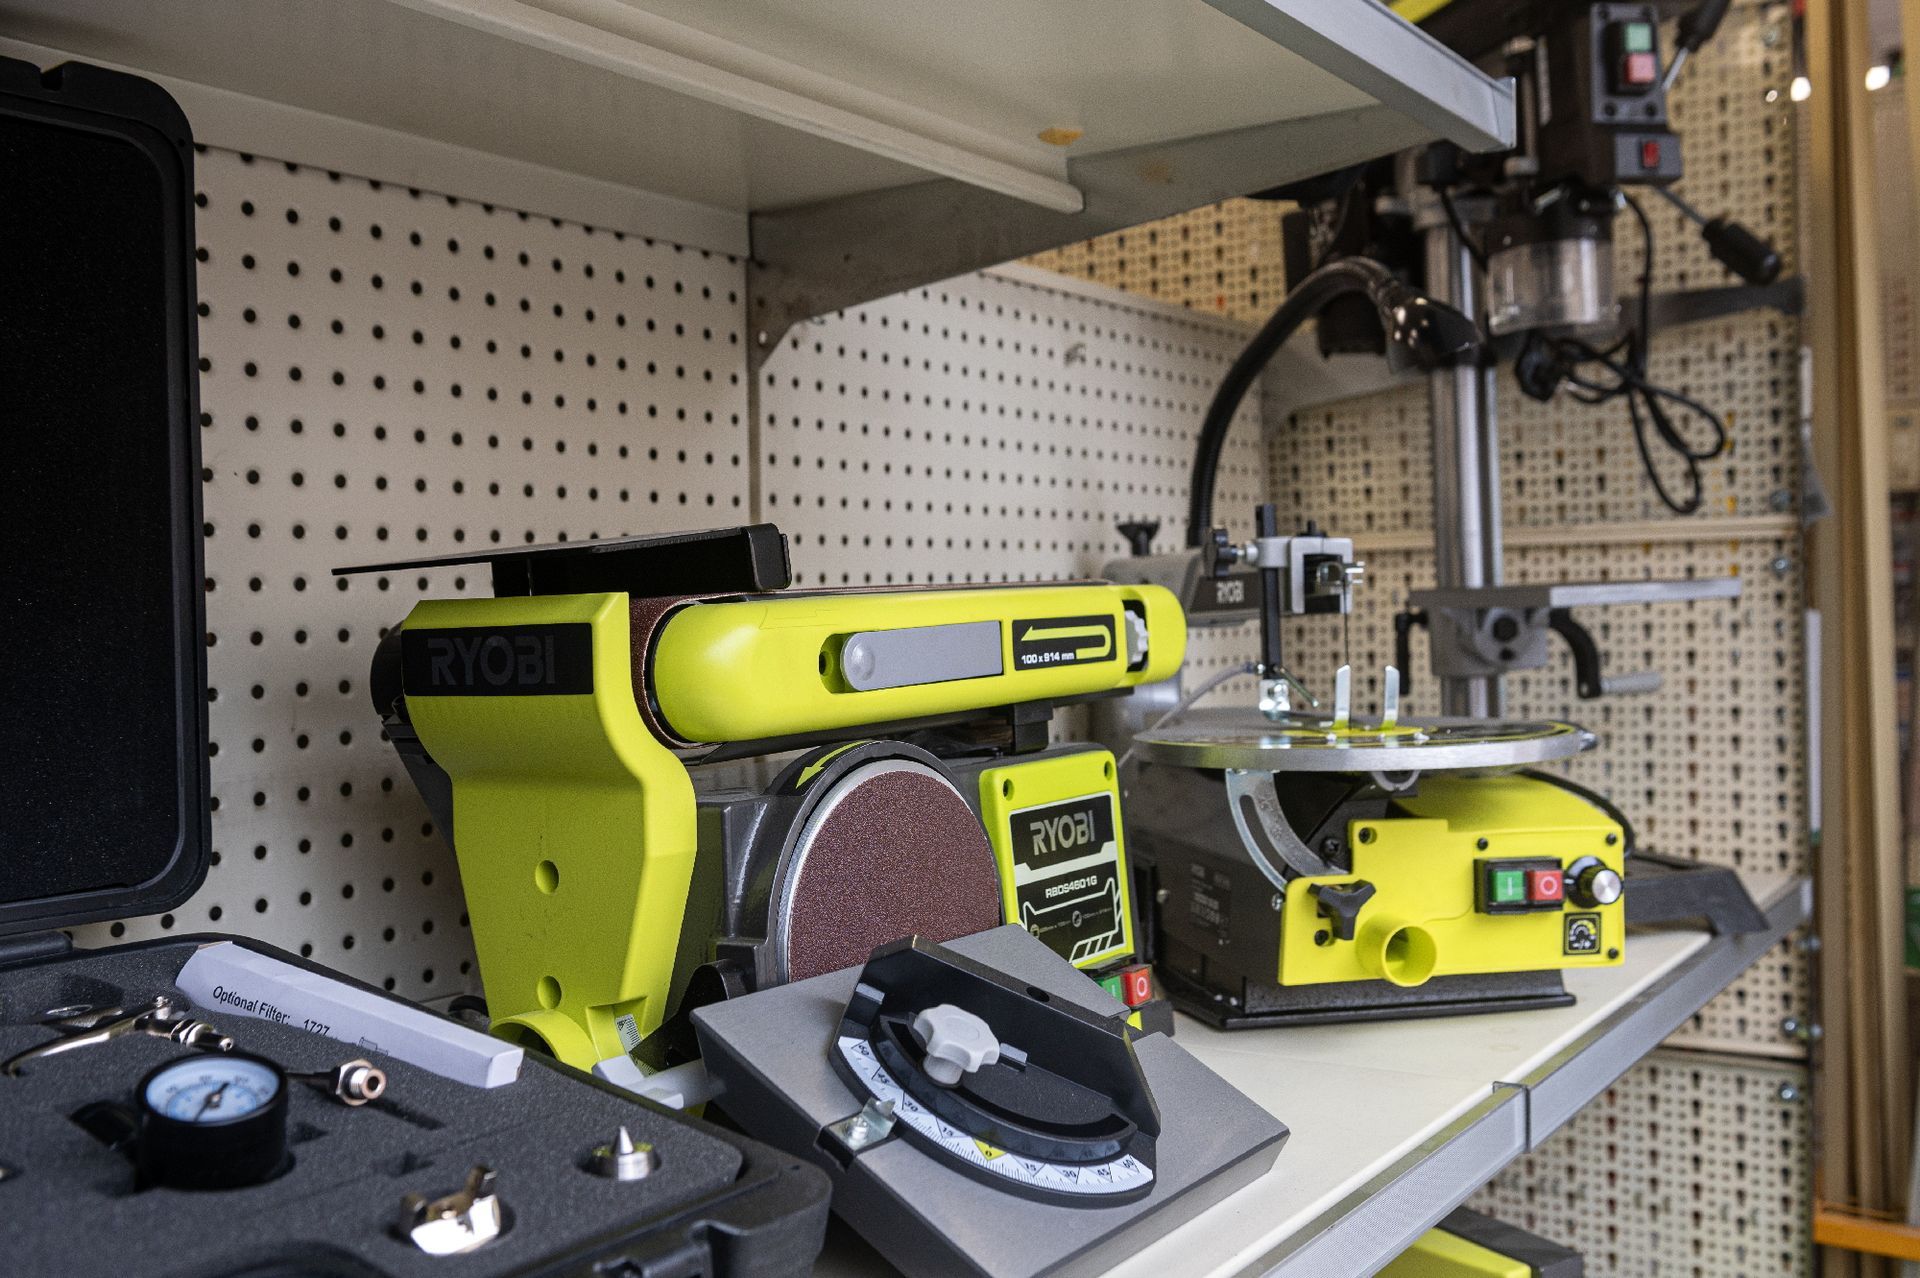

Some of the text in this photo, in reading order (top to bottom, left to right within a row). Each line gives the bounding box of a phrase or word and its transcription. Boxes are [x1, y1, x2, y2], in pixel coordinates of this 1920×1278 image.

[427, 635, 556, 686] RYOBI
[1021, 653, 1038, 664] 100
[1043, 651, 1060, 662] 914
[1061, 652, 1075, 660] mm
[1030, 810, 1096, 856] RYOBI
[213, 986, 258, 1013] Optional
[259, 1003, 291, 1025] Filter:
[904, 1100, 919, 1113] 30
[942, 1126, 954, 1137] 15
[985, 1149, 993, 1158] 0
[1024, 1162, 1037, 1173] 15
[1121, 1159, 1135, 1170] 60
[1061, 1168, 1077, 1179] 30
[1096, 1168, 1111, 1178] 45
